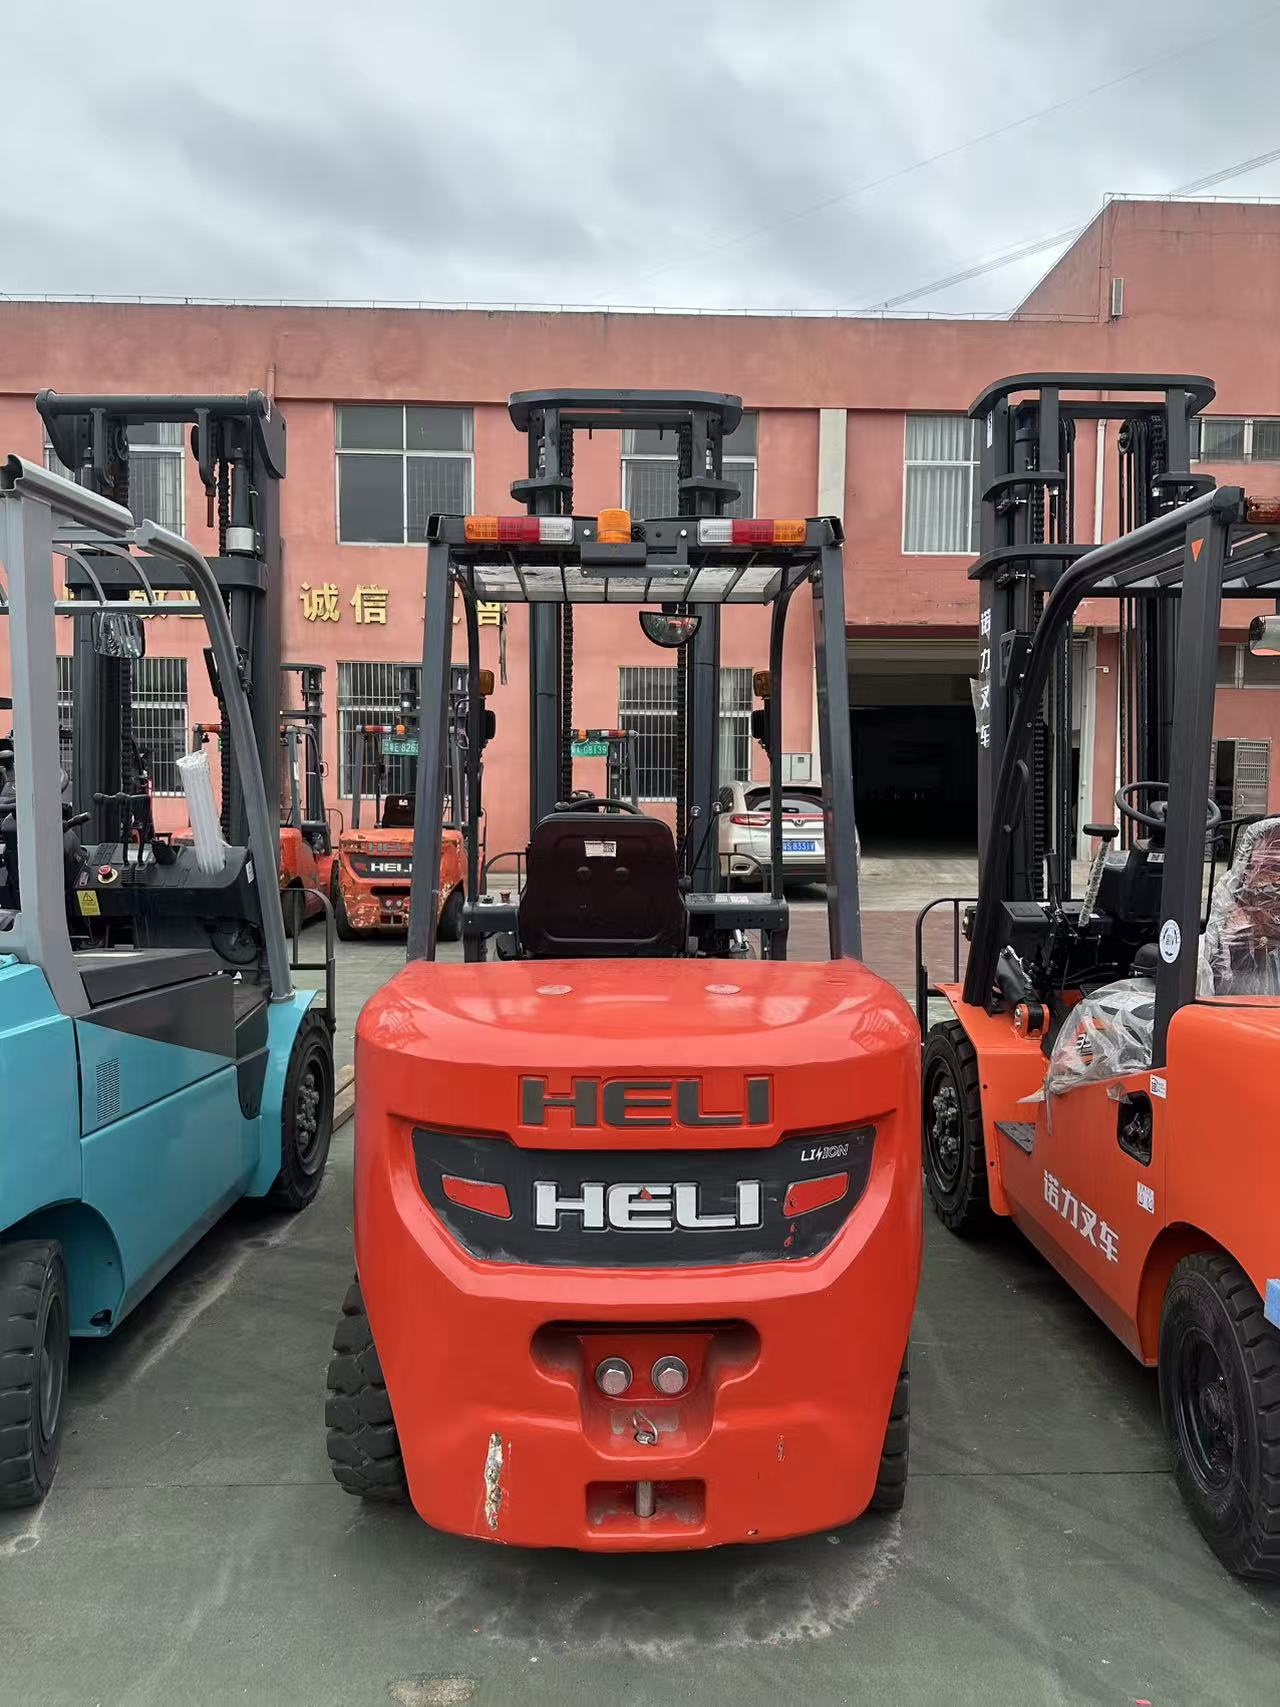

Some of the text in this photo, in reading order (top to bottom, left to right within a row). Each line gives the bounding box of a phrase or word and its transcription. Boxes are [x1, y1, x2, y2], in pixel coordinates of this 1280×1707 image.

[300, 582, 389, 624] 诚信
[980, 608, 991, 748] 诺力叉车
[520, 1076, 772, 1128] HELI
[534, 1181, 763, 1231] HELI
[1044, 1169, 1120, 1263] 诺力叉车
